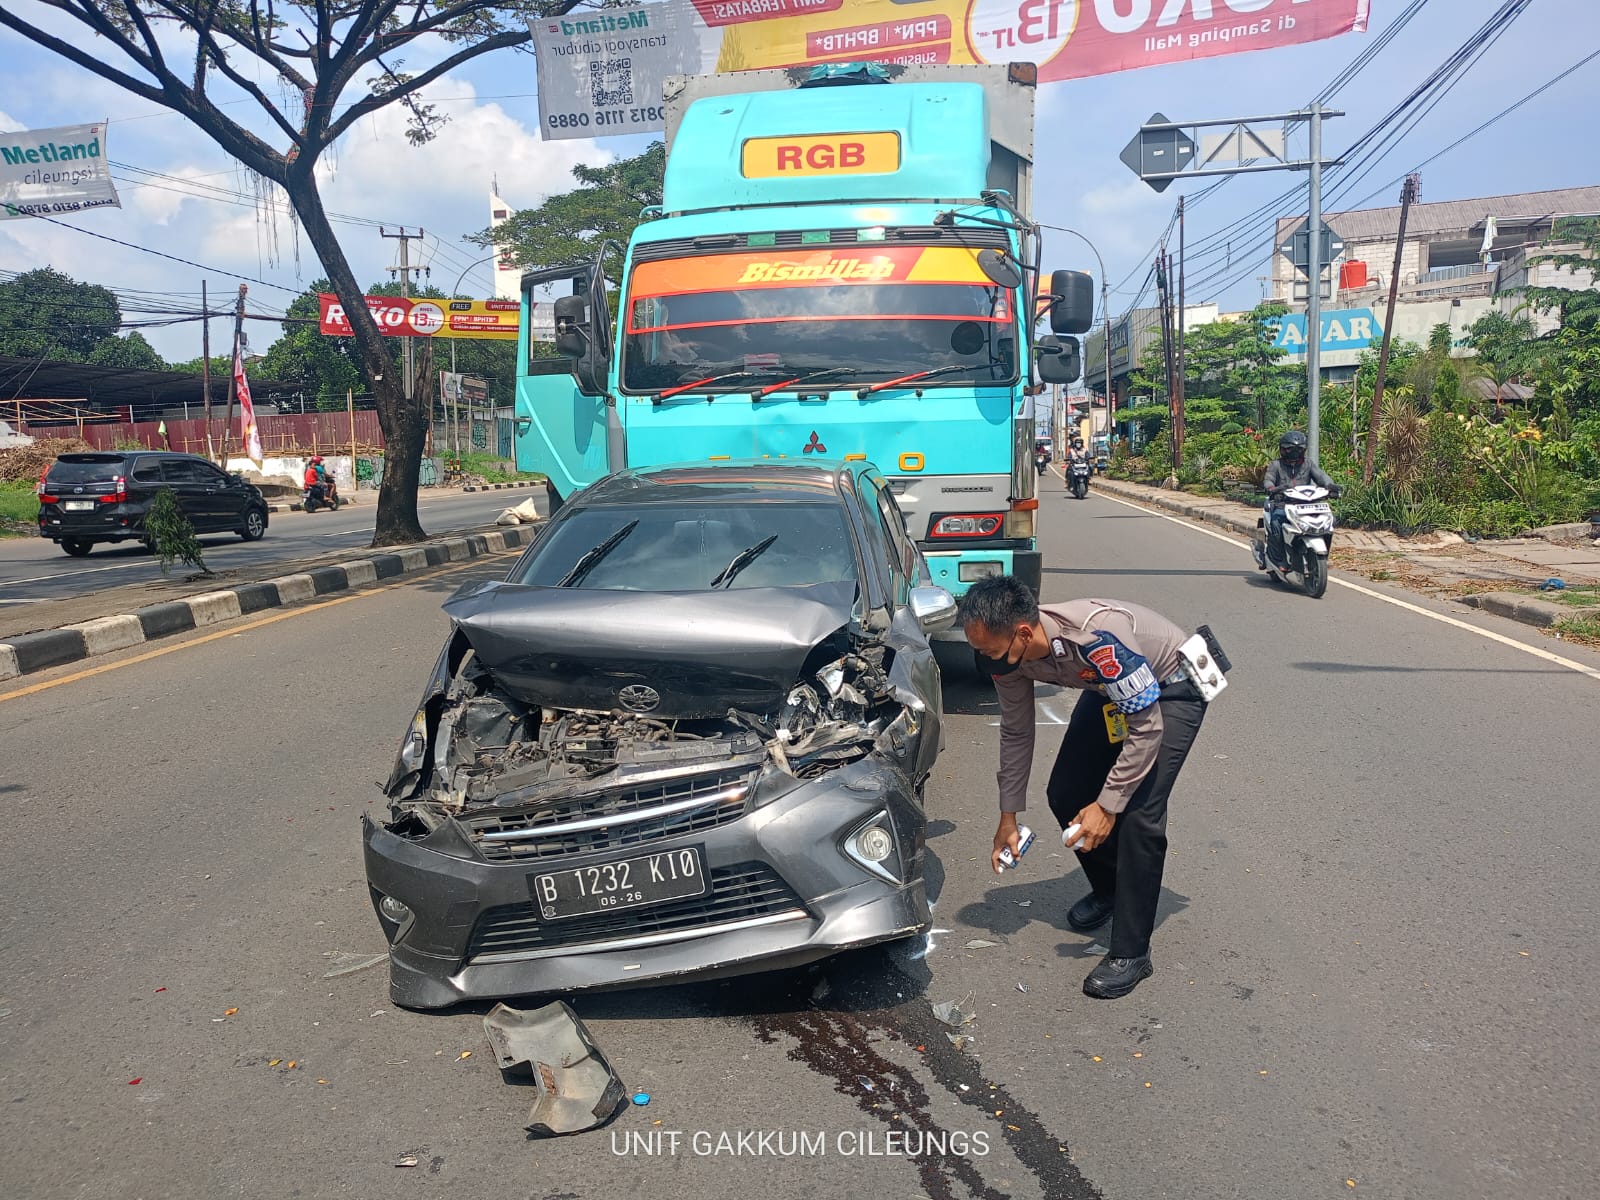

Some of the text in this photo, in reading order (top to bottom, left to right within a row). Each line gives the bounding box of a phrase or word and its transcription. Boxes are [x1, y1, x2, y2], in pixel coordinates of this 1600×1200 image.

[0, 137, 100, 166] Metland
[777, 142, 866, 171] RGB
[24, 165, 93, 185] cileungsi
[19, 203, 51, 215] 0878
[52, 201, 81, 212] 0138
[738, 255, 896, 283] Bismillah
[325, 304, 405, 327] RKO
[413, 312, 429, 327] 13
[541, 876, 558, 902] B
[574, 862, 633, 897] 1232
